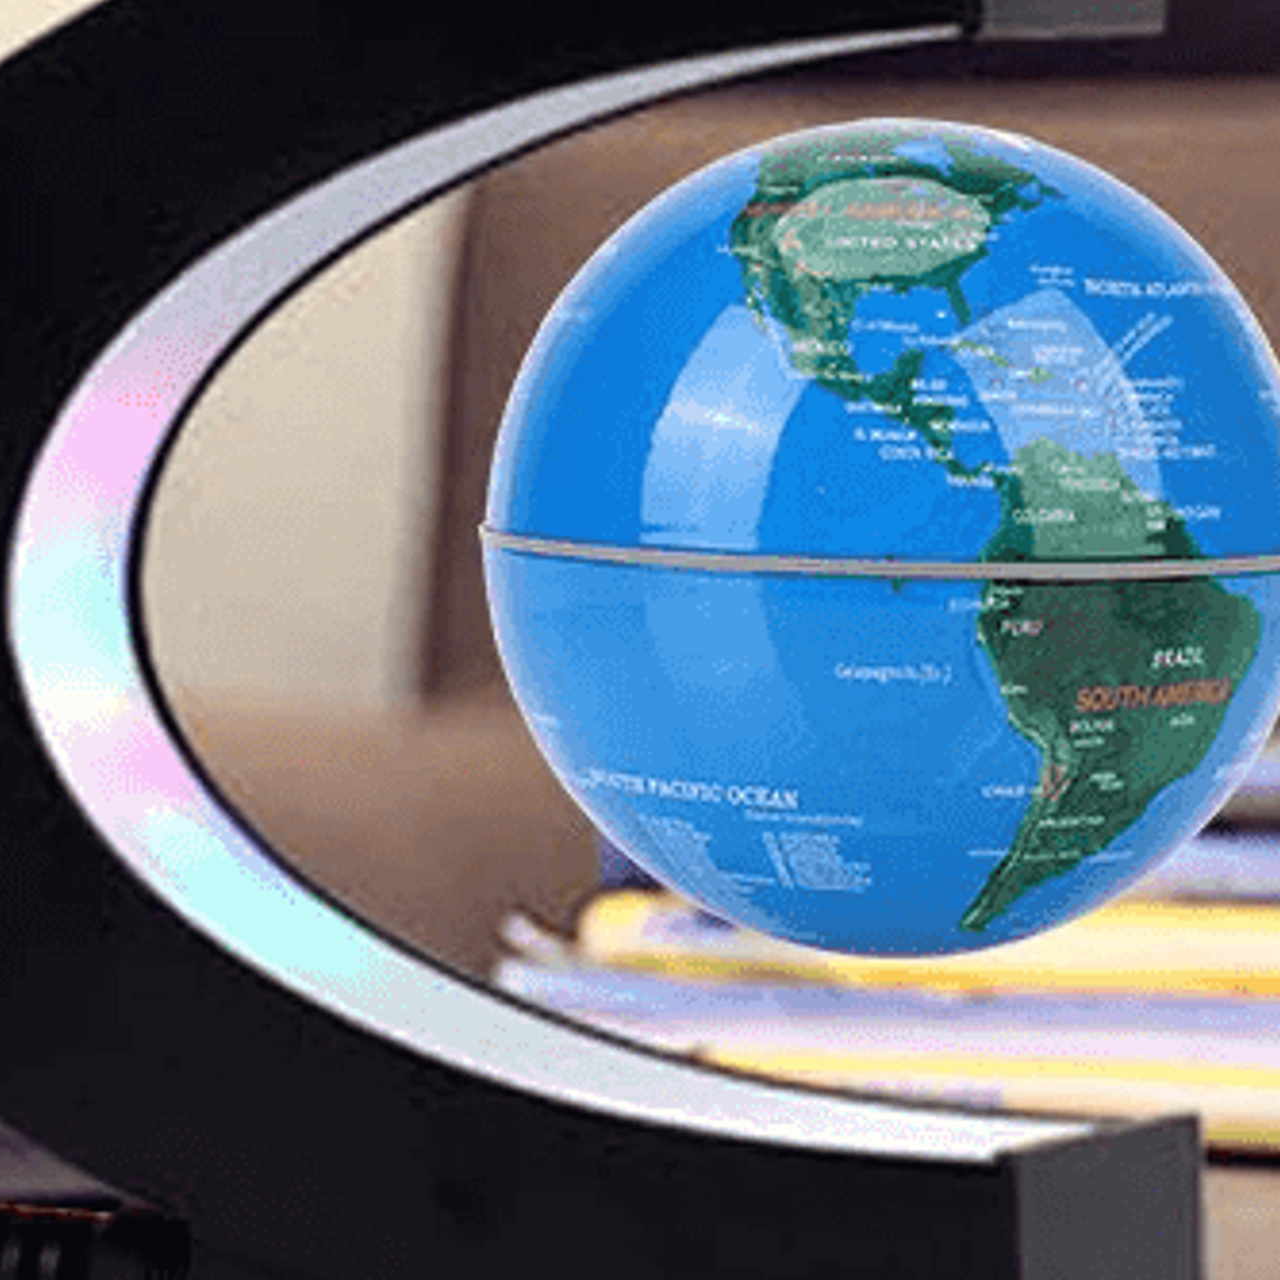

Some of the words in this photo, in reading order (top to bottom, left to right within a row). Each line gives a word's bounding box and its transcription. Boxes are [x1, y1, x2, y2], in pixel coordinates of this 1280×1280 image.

[1075, 684, 1148, 714] SOUTH
[1152, 675, 1233, 710] AMERICA
[648, 777, 723, 803] PACIFIC
[726, 783, 800, 810] OCEAN
